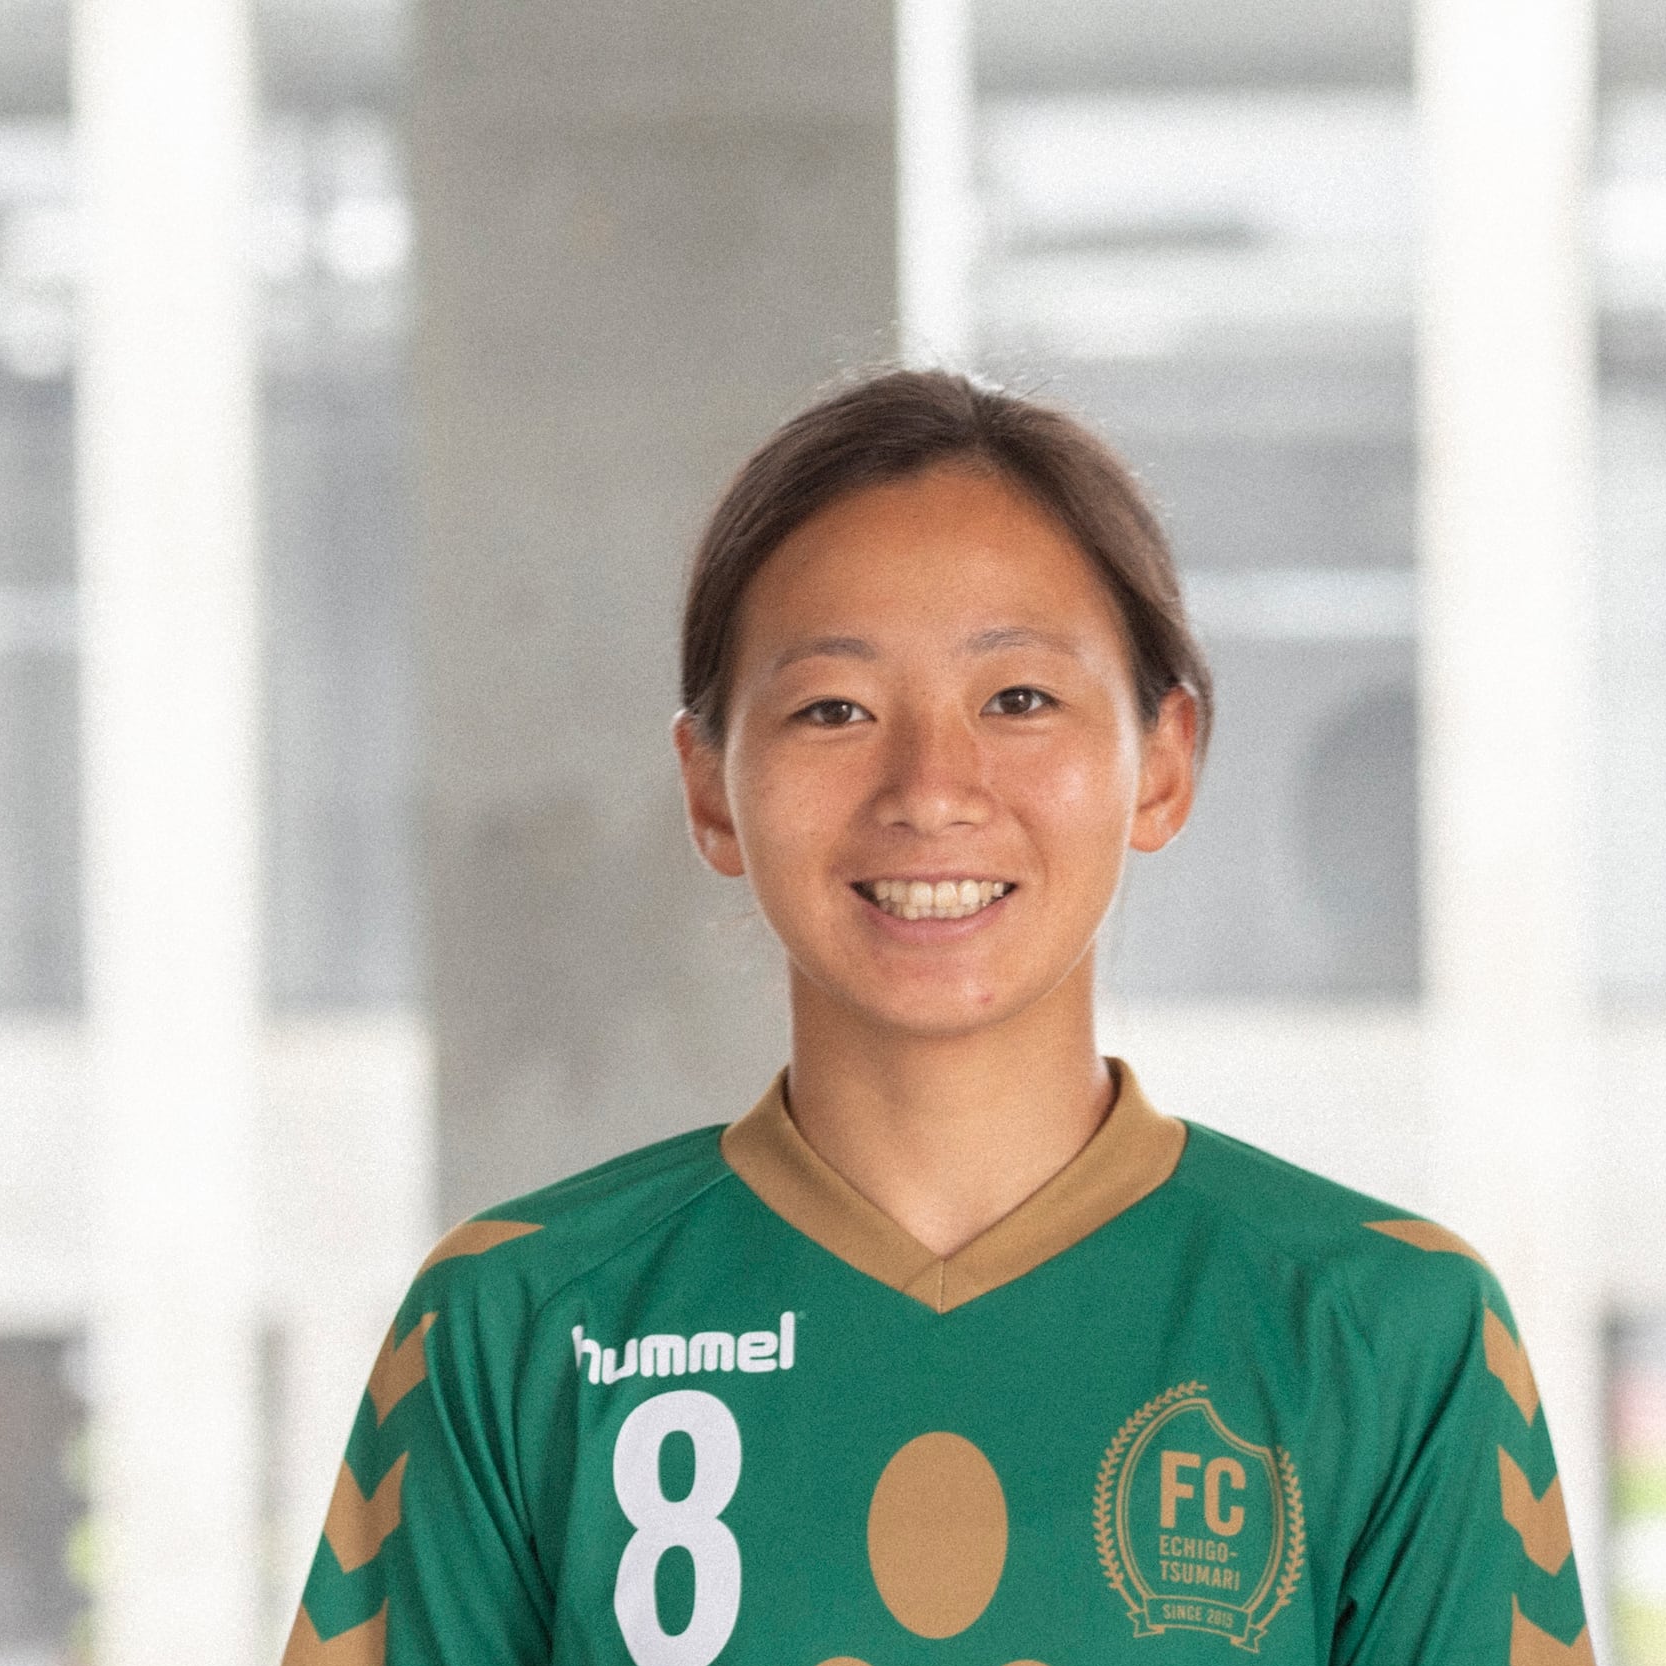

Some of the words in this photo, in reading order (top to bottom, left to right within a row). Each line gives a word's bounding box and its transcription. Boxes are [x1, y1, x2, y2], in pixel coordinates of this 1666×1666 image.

[572, 1311, 795, 1385] hummel
[1159, 1450, 1247, 1537] FC
[1159, 1534, 1238, 1563] ECHIGO-
[1159, 1560, 1241, 1591] TSUMARI
[1162, 1603, 1202, 1622] SINCE
